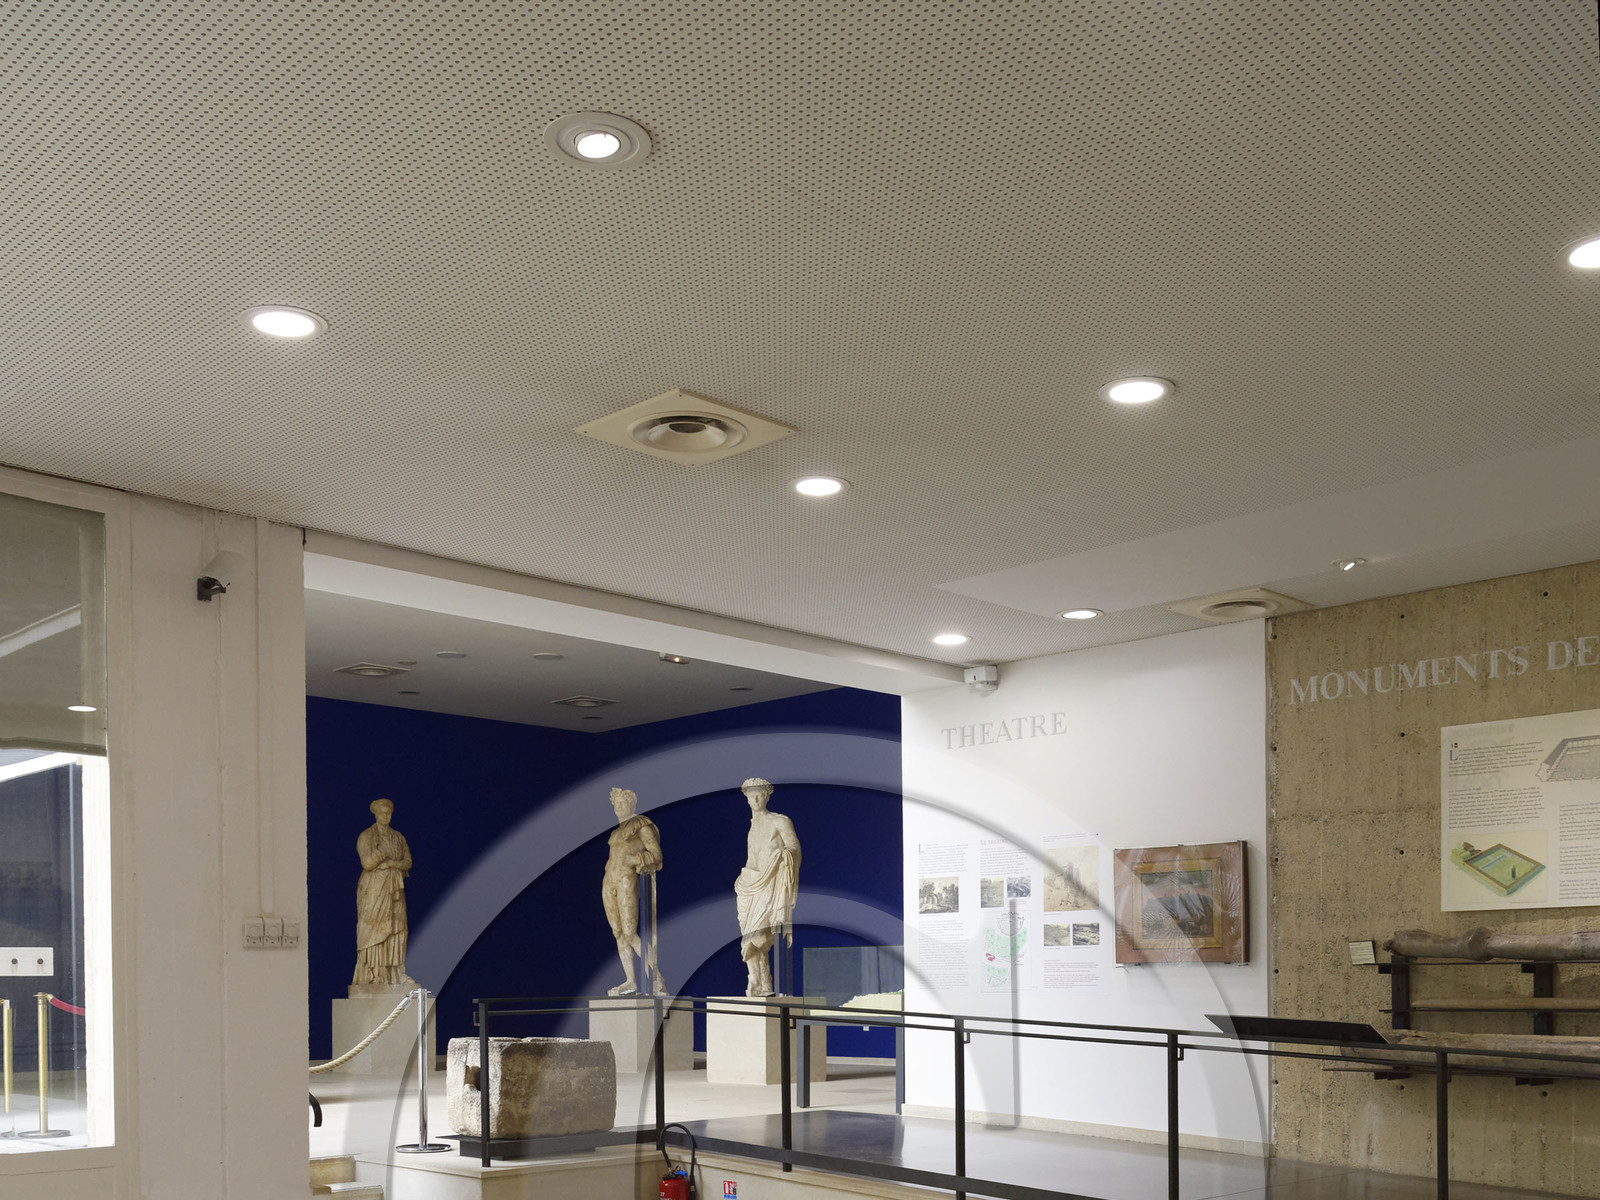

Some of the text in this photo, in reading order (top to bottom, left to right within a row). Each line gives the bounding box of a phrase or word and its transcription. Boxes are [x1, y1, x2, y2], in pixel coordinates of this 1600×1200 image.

[1290, 635, 1599, 705] MONUMENTS DE
[941, 712, 1068, 750] THEATRE
